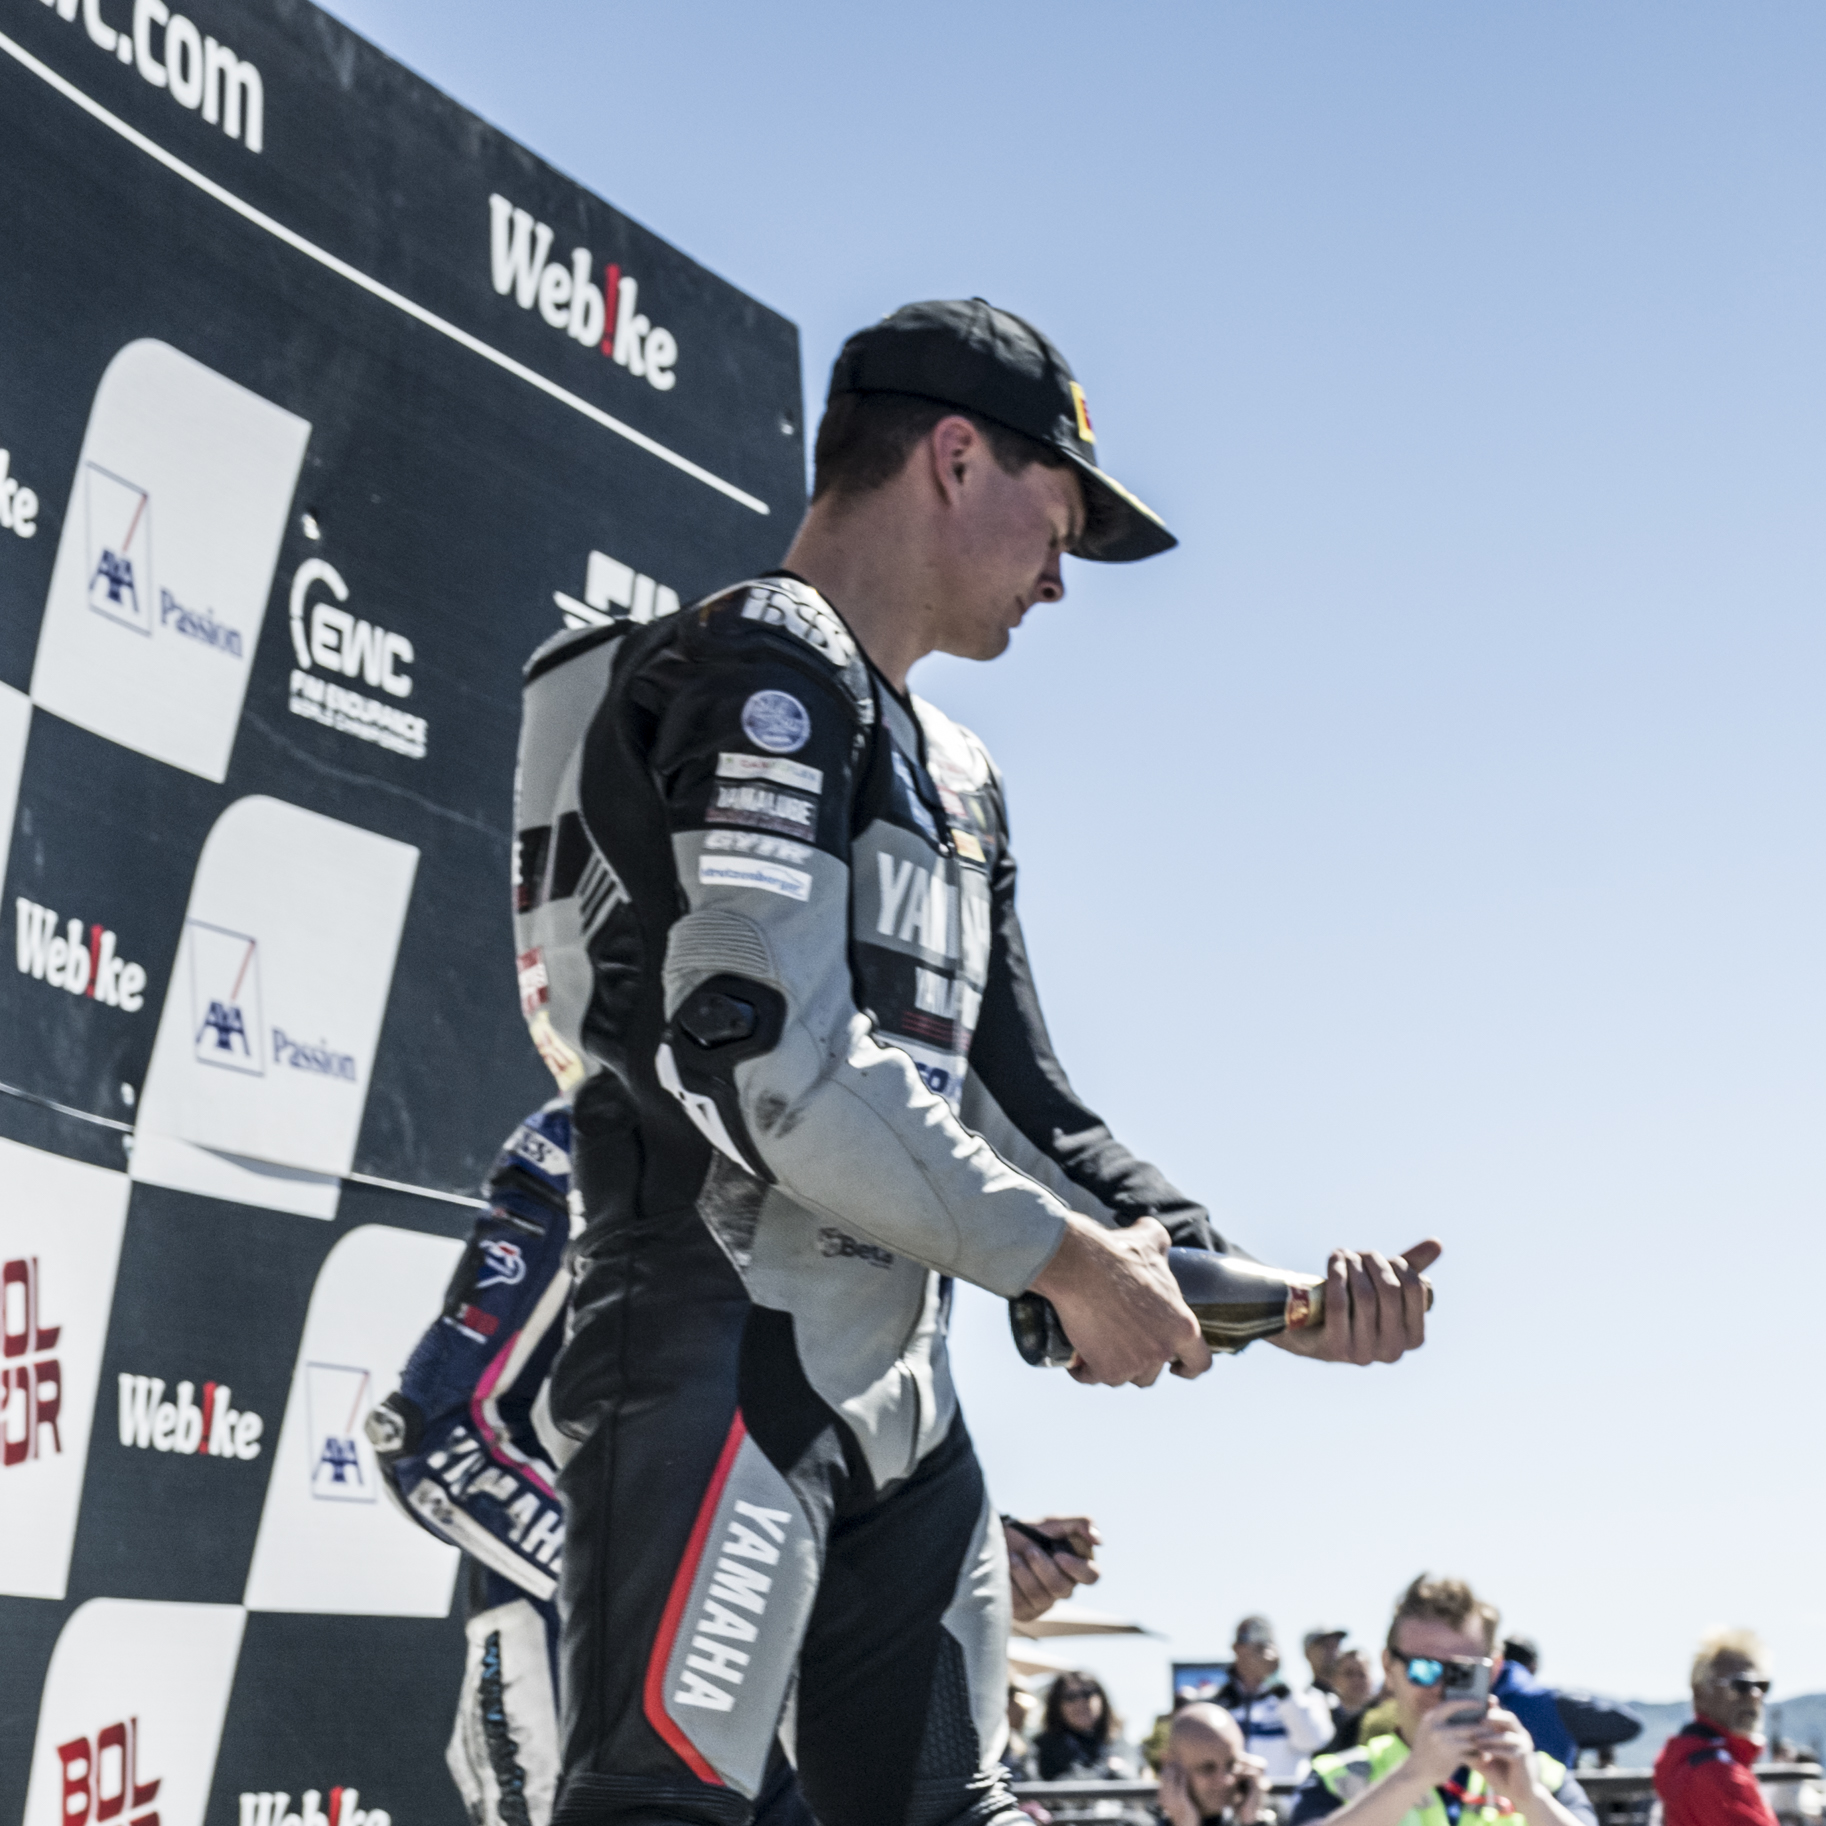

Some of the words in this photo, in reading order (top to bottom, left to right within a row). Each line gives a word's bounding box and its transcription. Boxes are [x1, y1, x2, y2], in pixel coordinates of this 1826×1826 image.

[160, 585, 243, 658] Passion
[311, 603, 414, 698] EWC
[271, 1028, 357, 1084] Passion
[426, 1425, 566, 1575] YAMAH
[673, 1499, 792, 1713] YAMAHA
